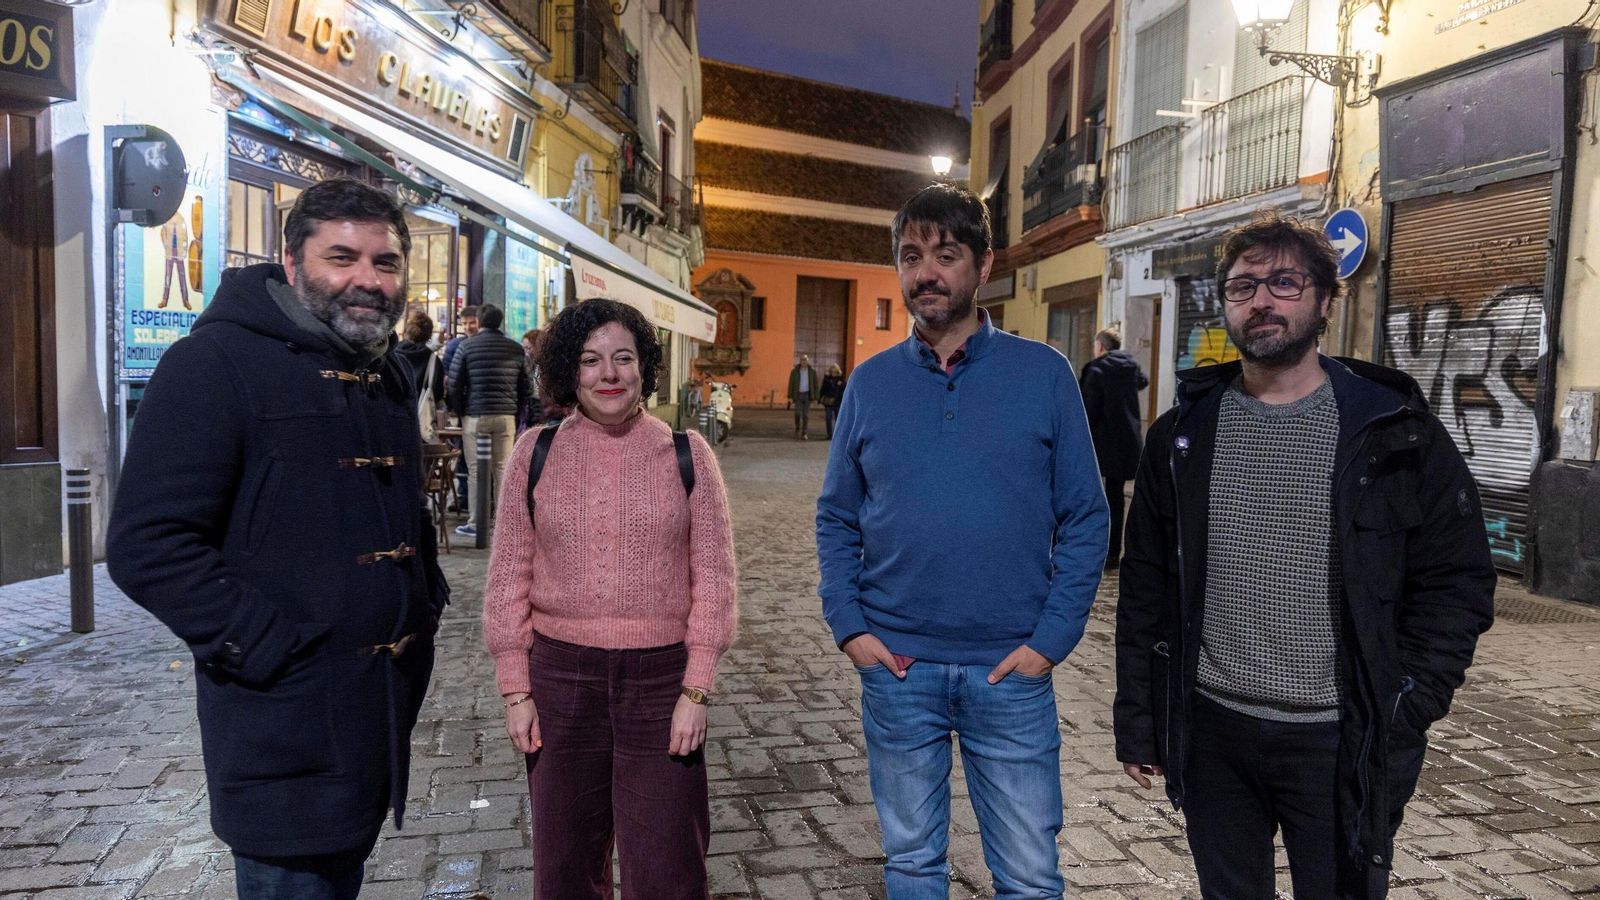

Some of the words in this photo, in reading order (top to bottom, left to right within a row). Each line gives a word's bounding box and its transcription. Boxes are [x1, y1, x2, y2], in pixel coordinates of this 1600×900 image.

[0, 18, 54, 71] OS
[289, 0, 359, 66] LOS
[377, 51, 501, 142] CLAVELES
[1144, 268, 1149, 280] 2
